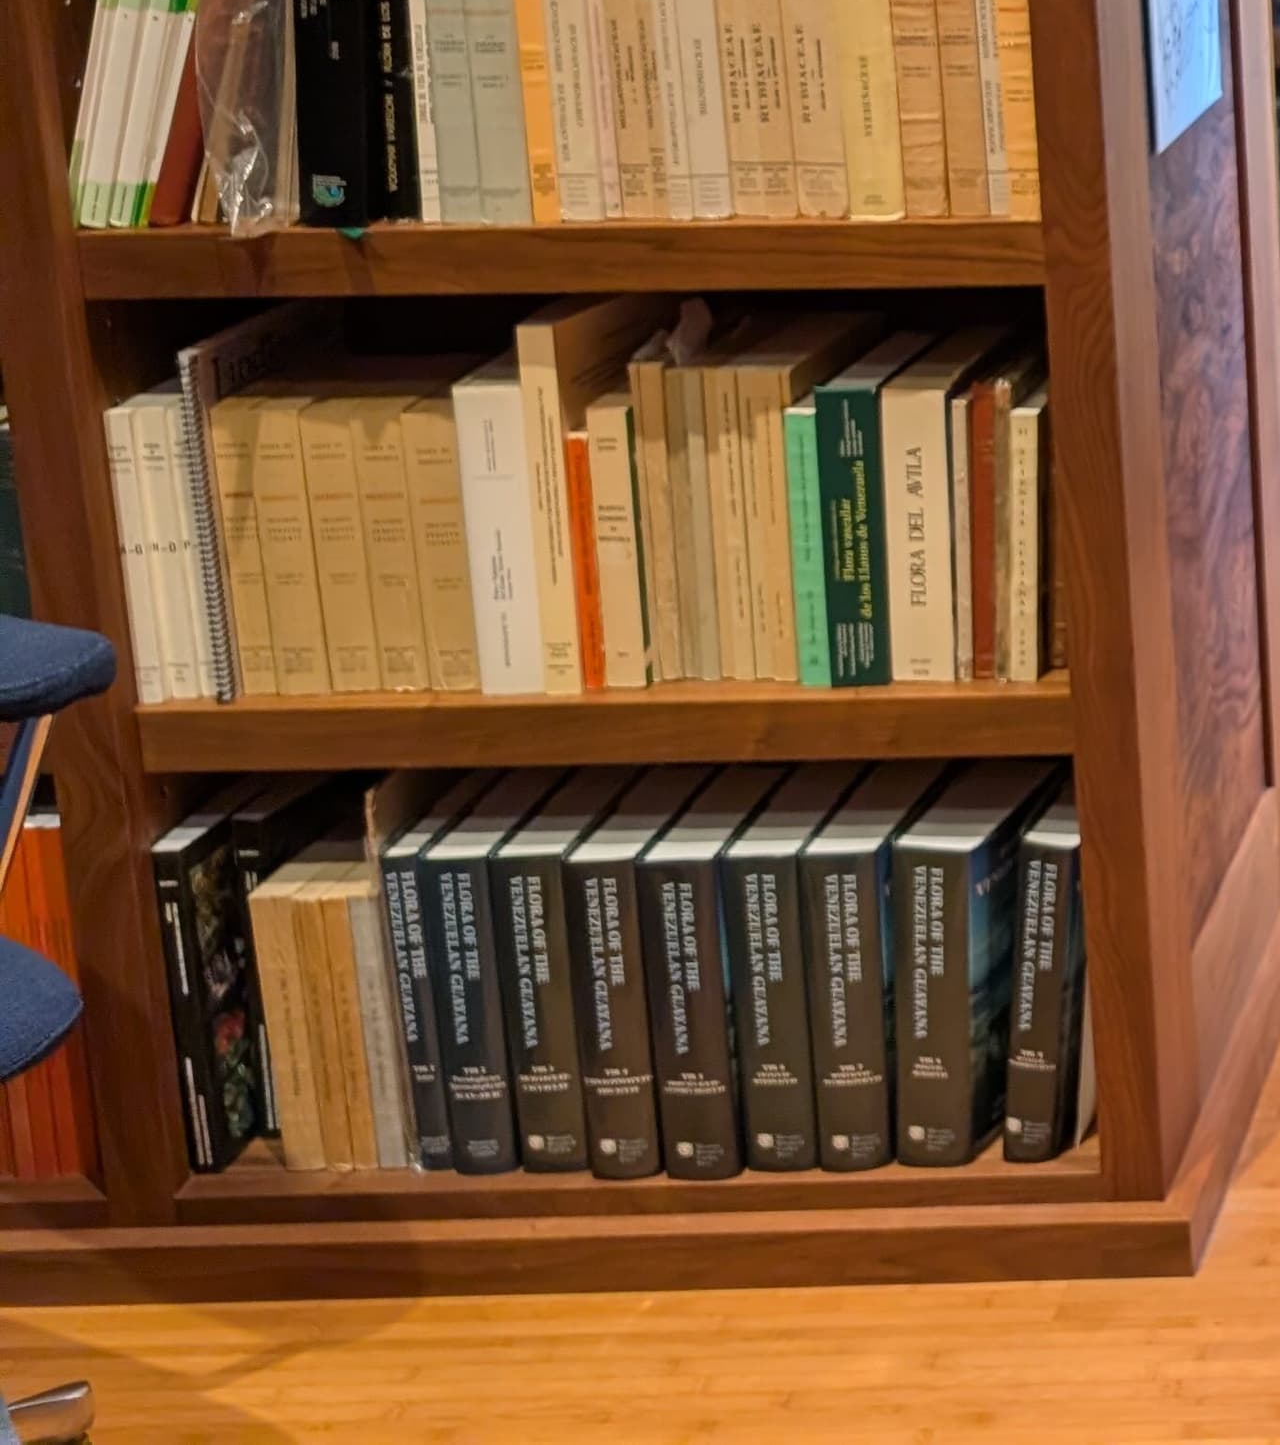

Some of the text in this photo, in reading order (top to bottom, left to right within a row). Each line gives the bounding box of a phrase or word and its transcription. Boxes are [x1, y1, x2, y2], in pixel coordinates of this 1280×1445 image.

[910, 507, 926, 542] DEL
[910, 549, 927, 607] FLORA
[585, 878, 606, 978] VENEZUELAN
[603, 878, 626, 987] FLORA OF THE
[913, 865, 927, 965] VENEZUELAN
[929, 866, 944, 978] FLORA OF THE
[1023, 860, 1042, 960] VENEZUELAN
[1037, 862, 1058, 971] FLORA OF THE
